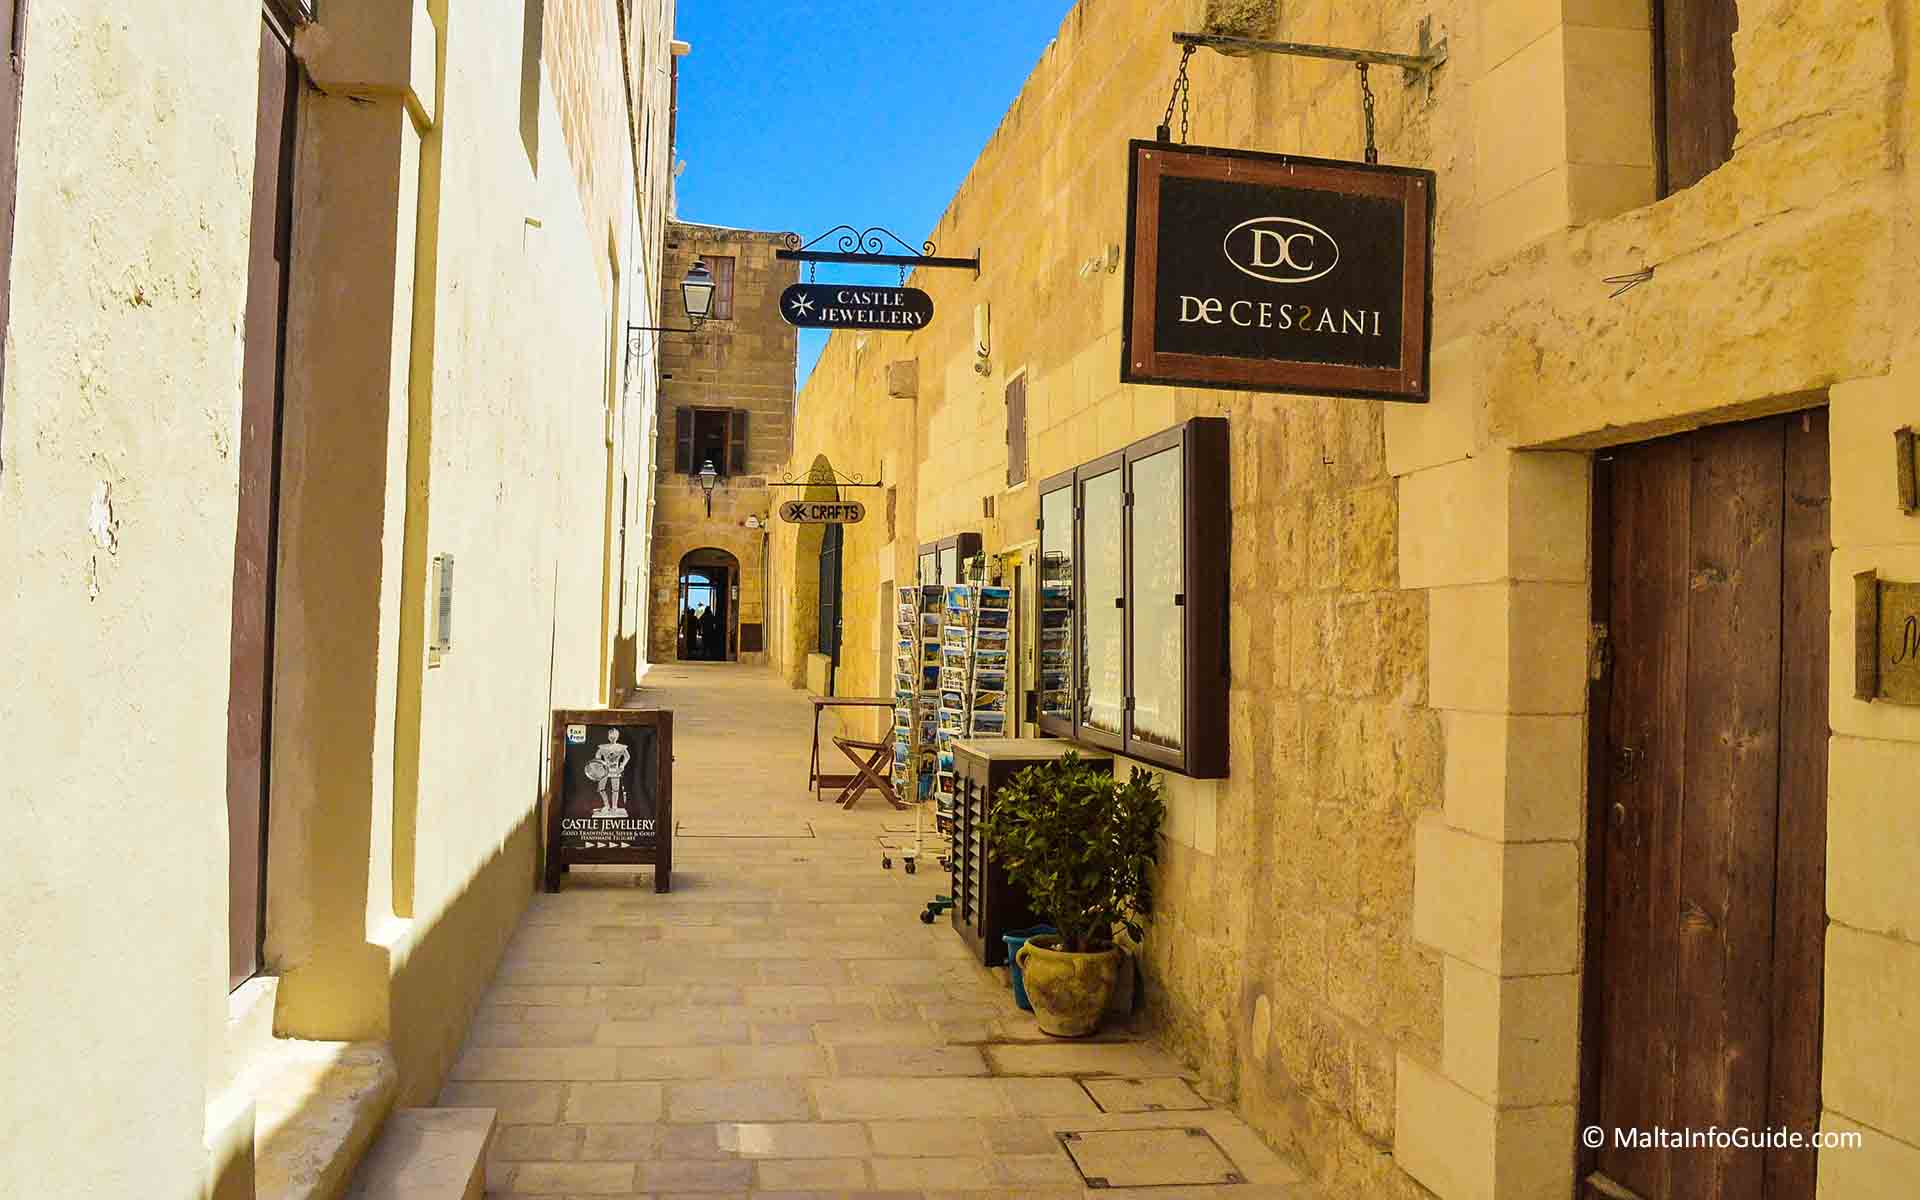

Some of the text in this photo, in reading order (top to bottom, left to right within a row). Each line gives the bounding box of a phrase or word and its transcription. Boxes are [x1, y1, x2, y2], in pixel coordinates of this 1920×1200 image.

[1250, 229, 1315, 271] DC
[837, 290, 905, 306] CASTLE
[818, 308, 926, 325] JEWELLERY
[811, 505, 859, 520] CRAFTS
[562, 819, 655, 831] CASTLE JEWELLERY
